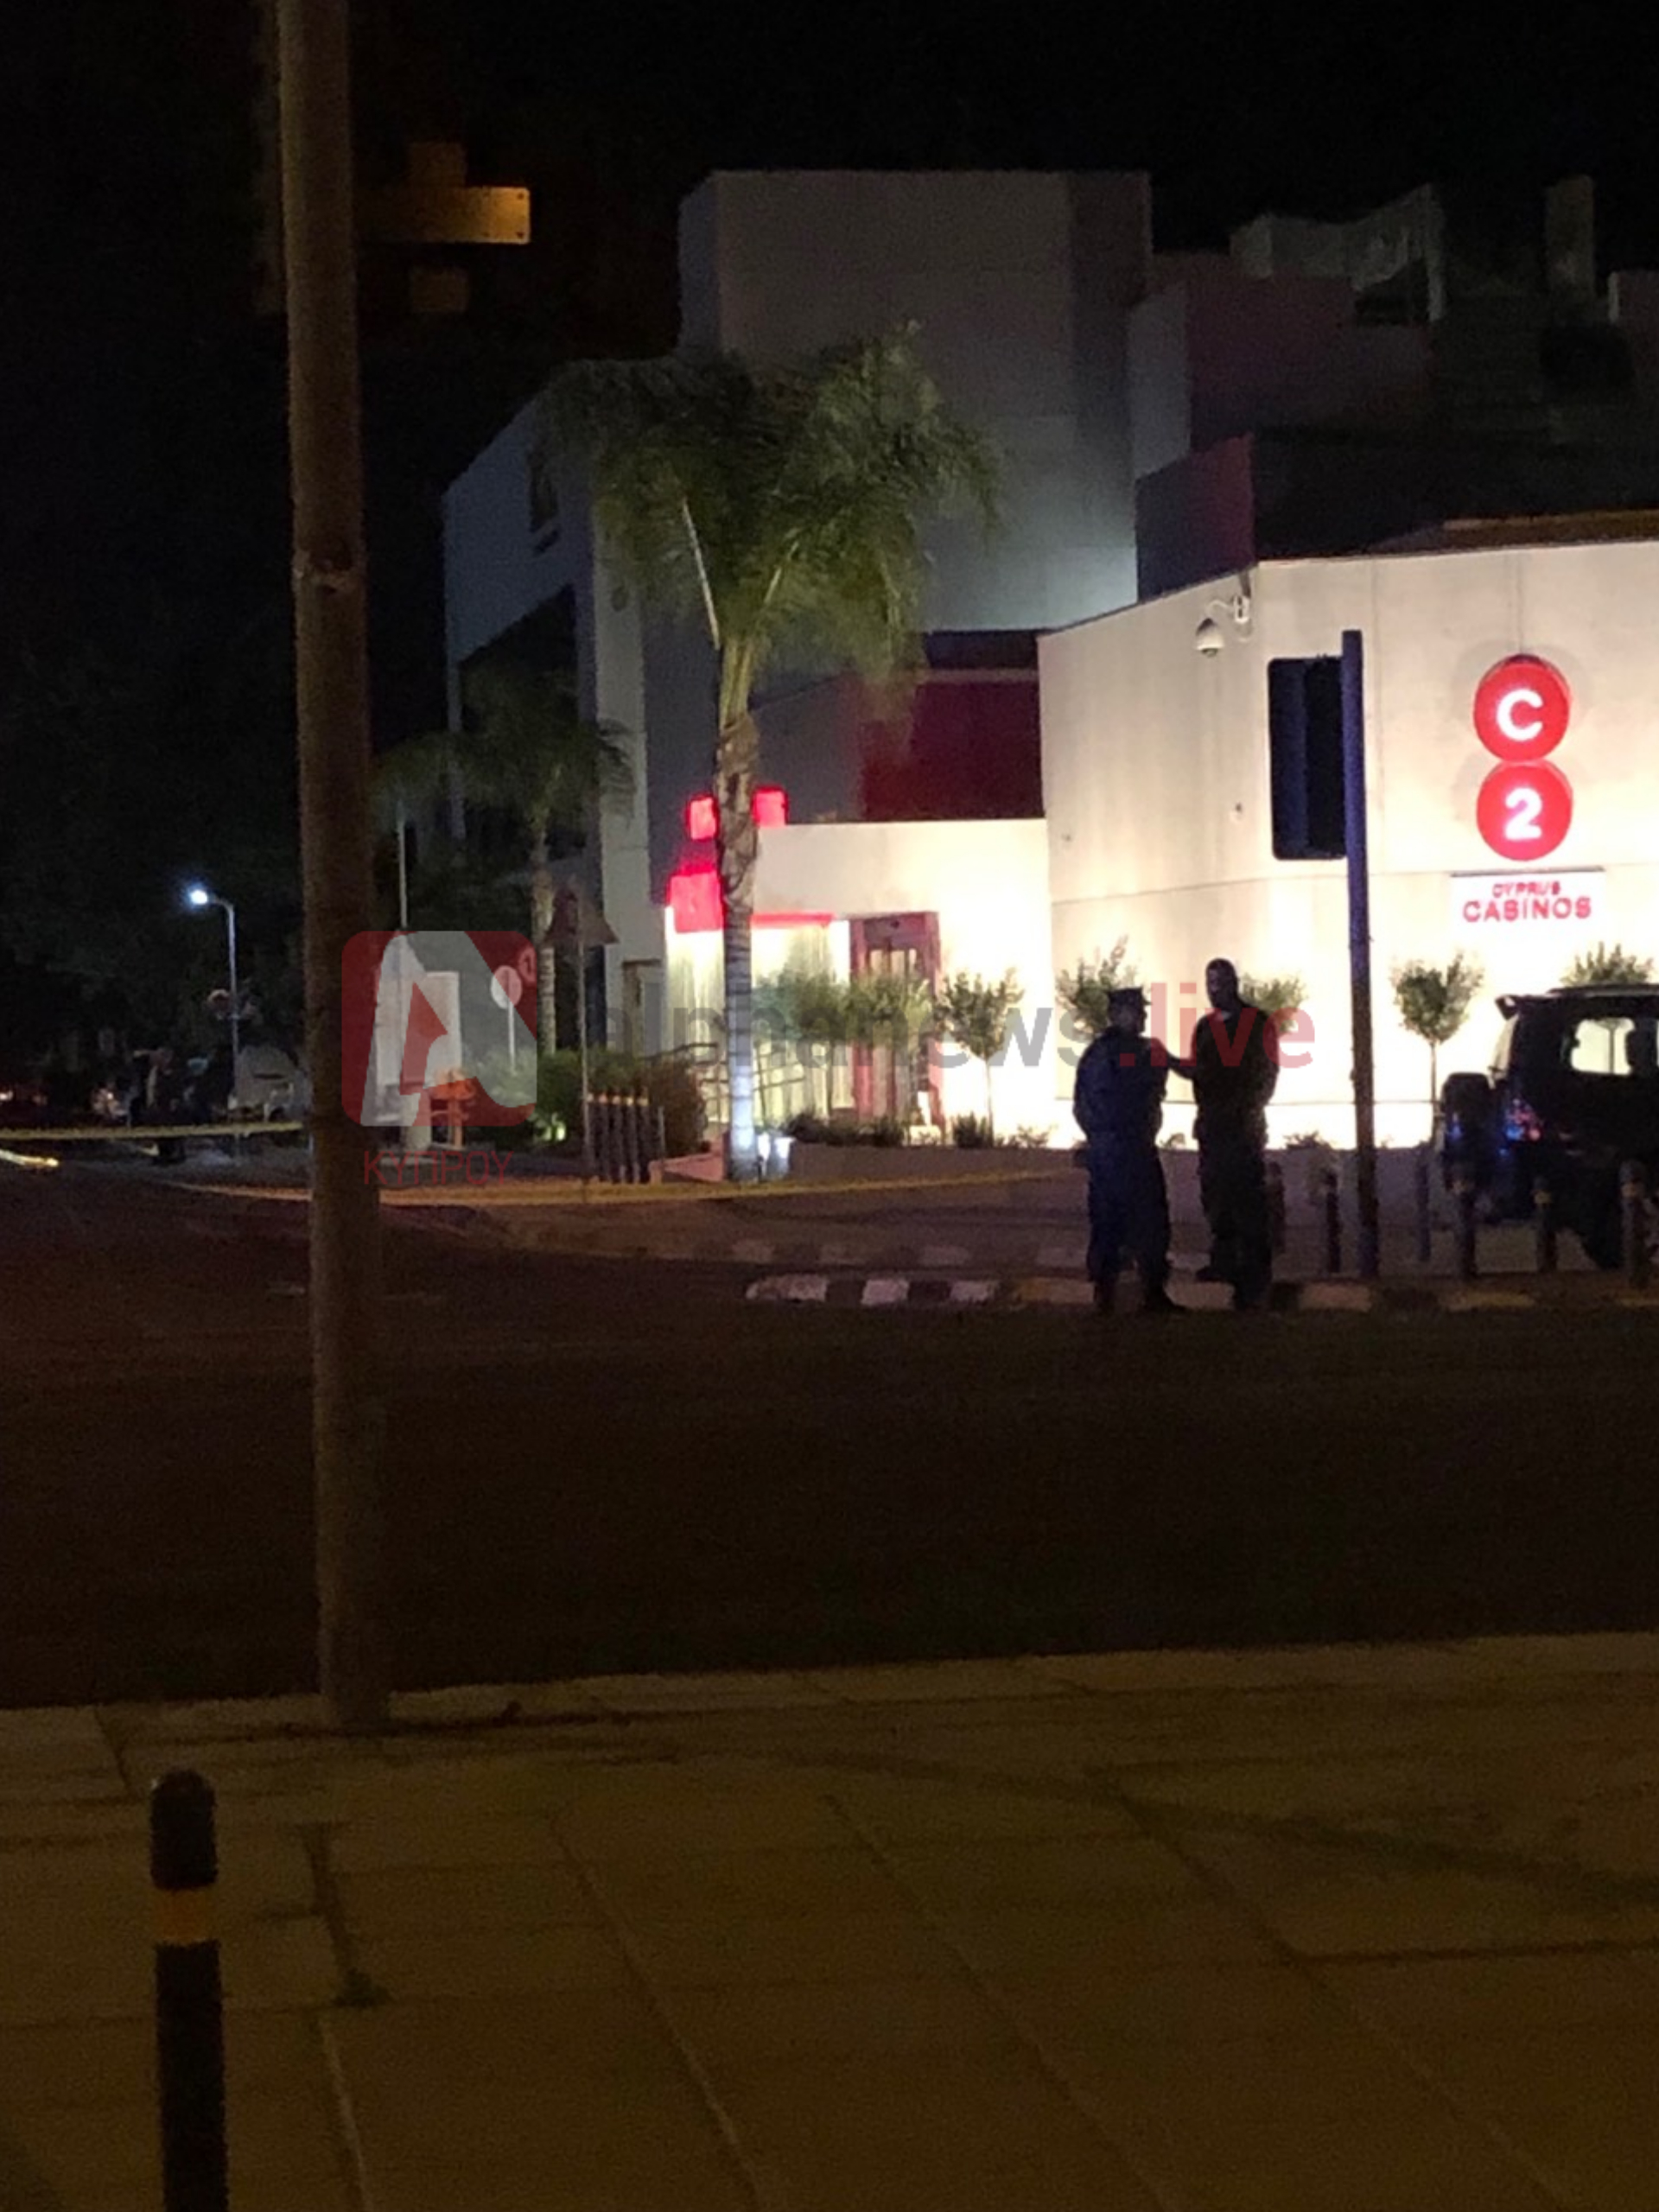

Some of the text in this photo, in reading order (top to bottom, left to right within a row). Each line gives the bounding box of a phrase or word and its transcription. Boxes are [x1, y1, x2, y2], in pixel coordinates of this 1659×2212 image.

[1496, 688, 1544, 741] C
[1504, 787, 1543, 840] 2
[1462, 896, 1592, 923] CASINOS
